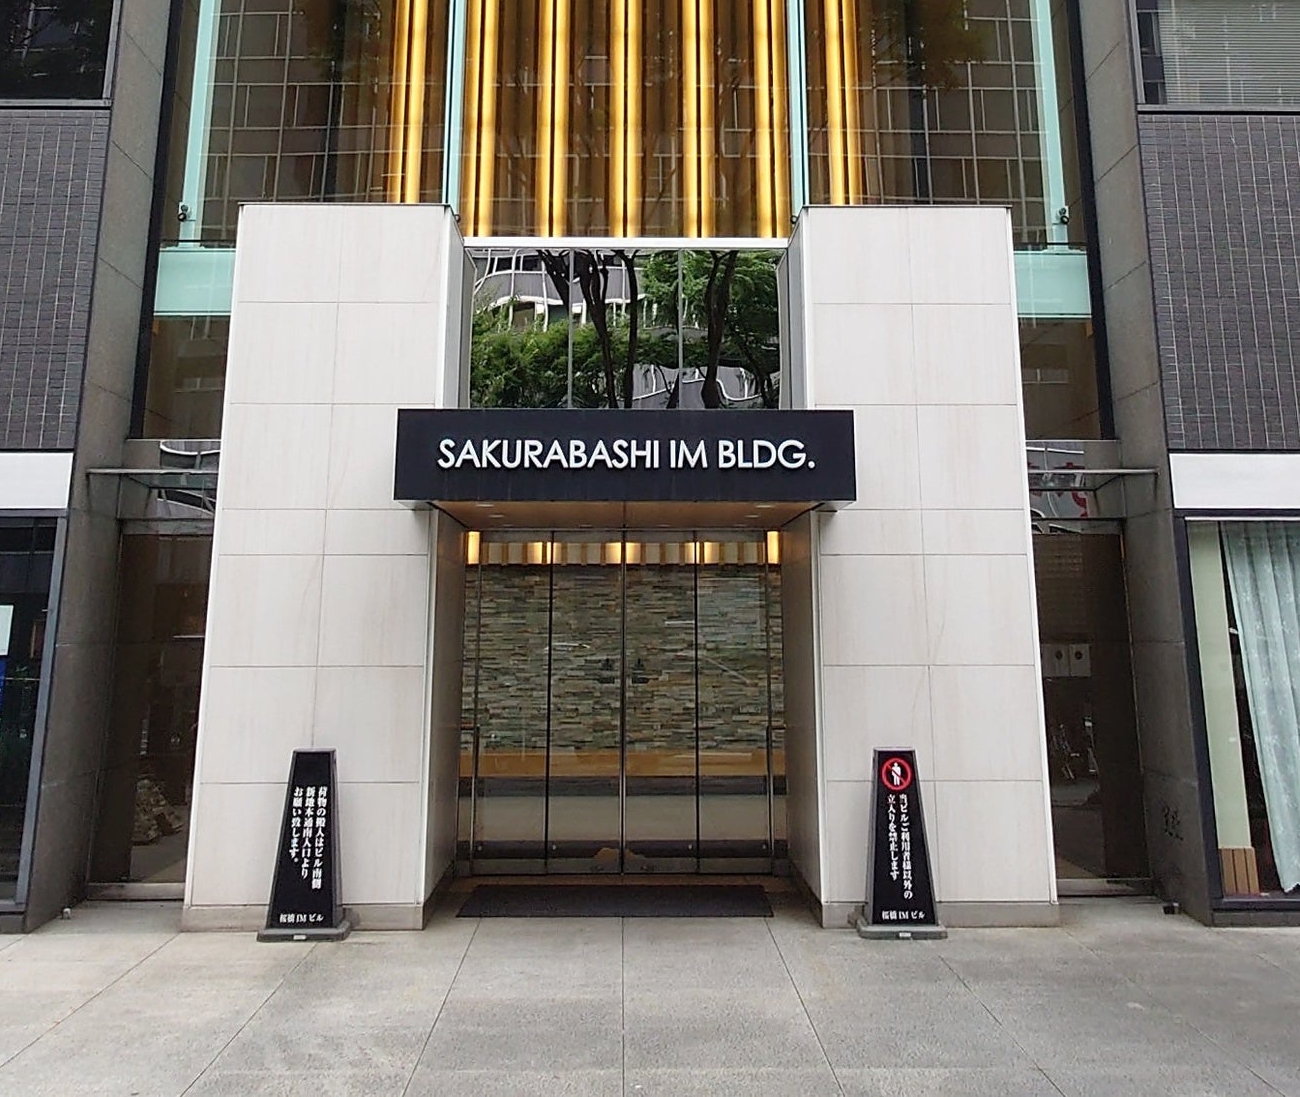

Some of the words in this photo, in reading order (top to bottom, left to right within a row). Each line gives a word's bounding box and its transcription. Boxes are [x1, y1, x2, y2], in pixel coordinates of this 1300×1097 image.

[437, 438, 660, 470] SAKURABASHI
[670, 439, 707, 470] IM
[717, 439, 816, 470] BLDG.
[886, 793, 900, 882] 立入りを禁止します
